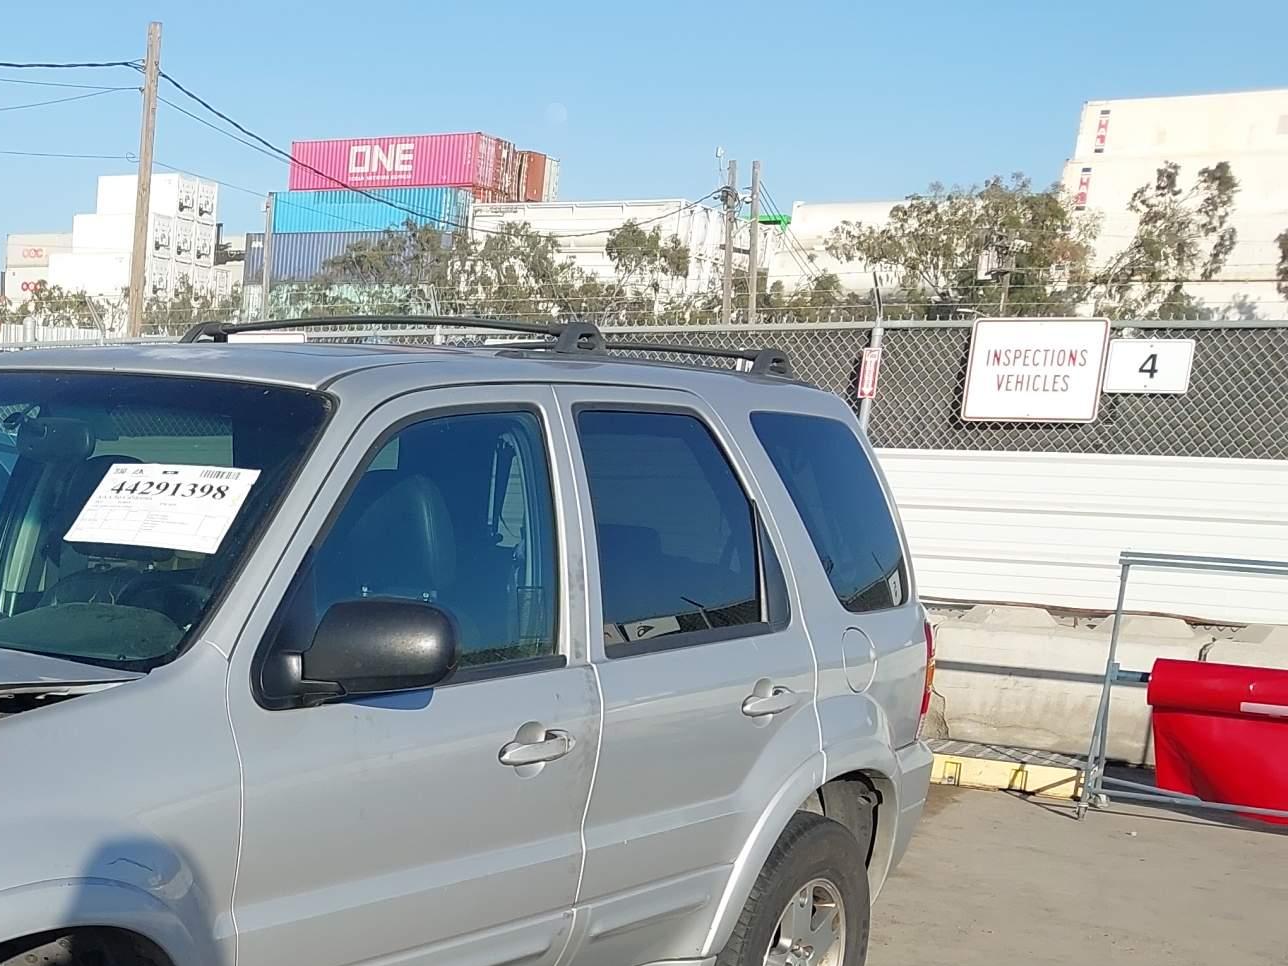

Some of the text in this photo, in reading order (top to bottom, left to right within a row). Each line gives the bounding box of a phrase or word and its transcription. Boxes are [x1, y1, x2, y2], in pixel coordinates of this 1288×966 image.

[349, 143, 415, 173] ONE
[986, 349, 1088, 367] INSPECTIONS
[1138, 353, 1158, 379] 4
[996, 374, 1070, 392] VEHICLES
[111, 480, 229, 500] 44291398
